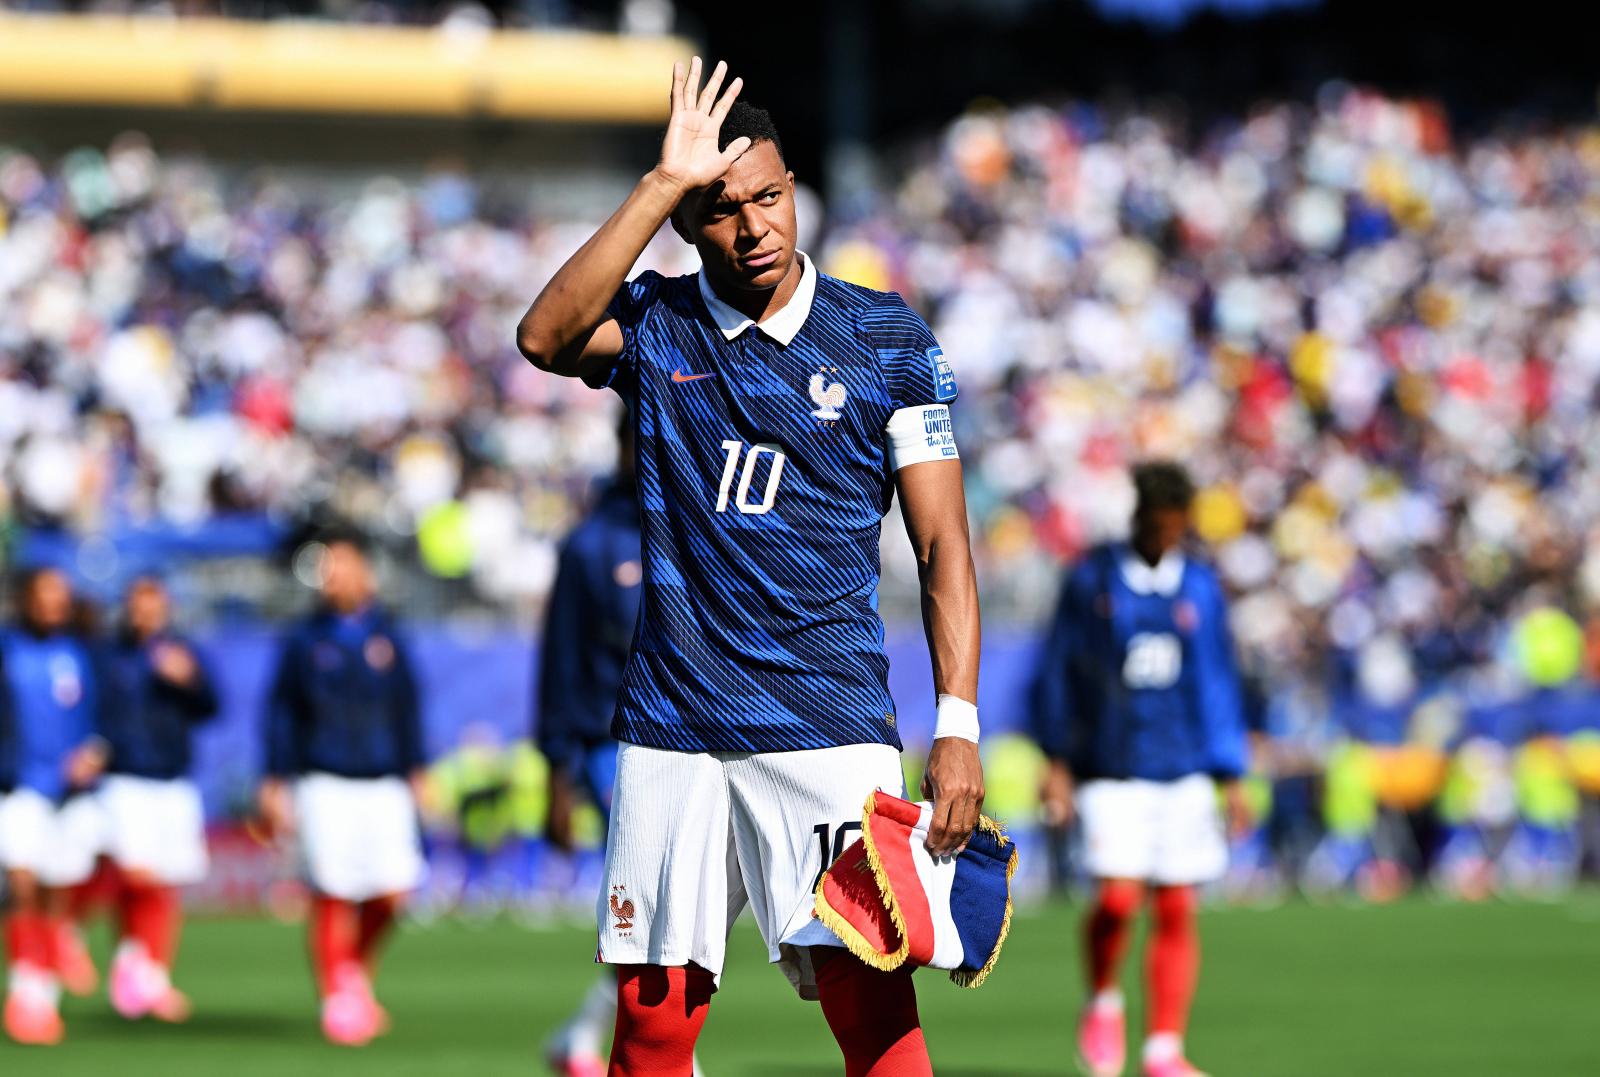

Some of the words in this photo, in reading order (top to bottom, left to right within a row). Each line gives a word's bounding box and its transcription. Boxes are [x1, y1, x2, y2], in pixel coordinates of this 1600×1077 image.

[925, 419, 951, 434] UNITE
[925, 434, 940, 447] the
[716, 440, 785, 514] 10
